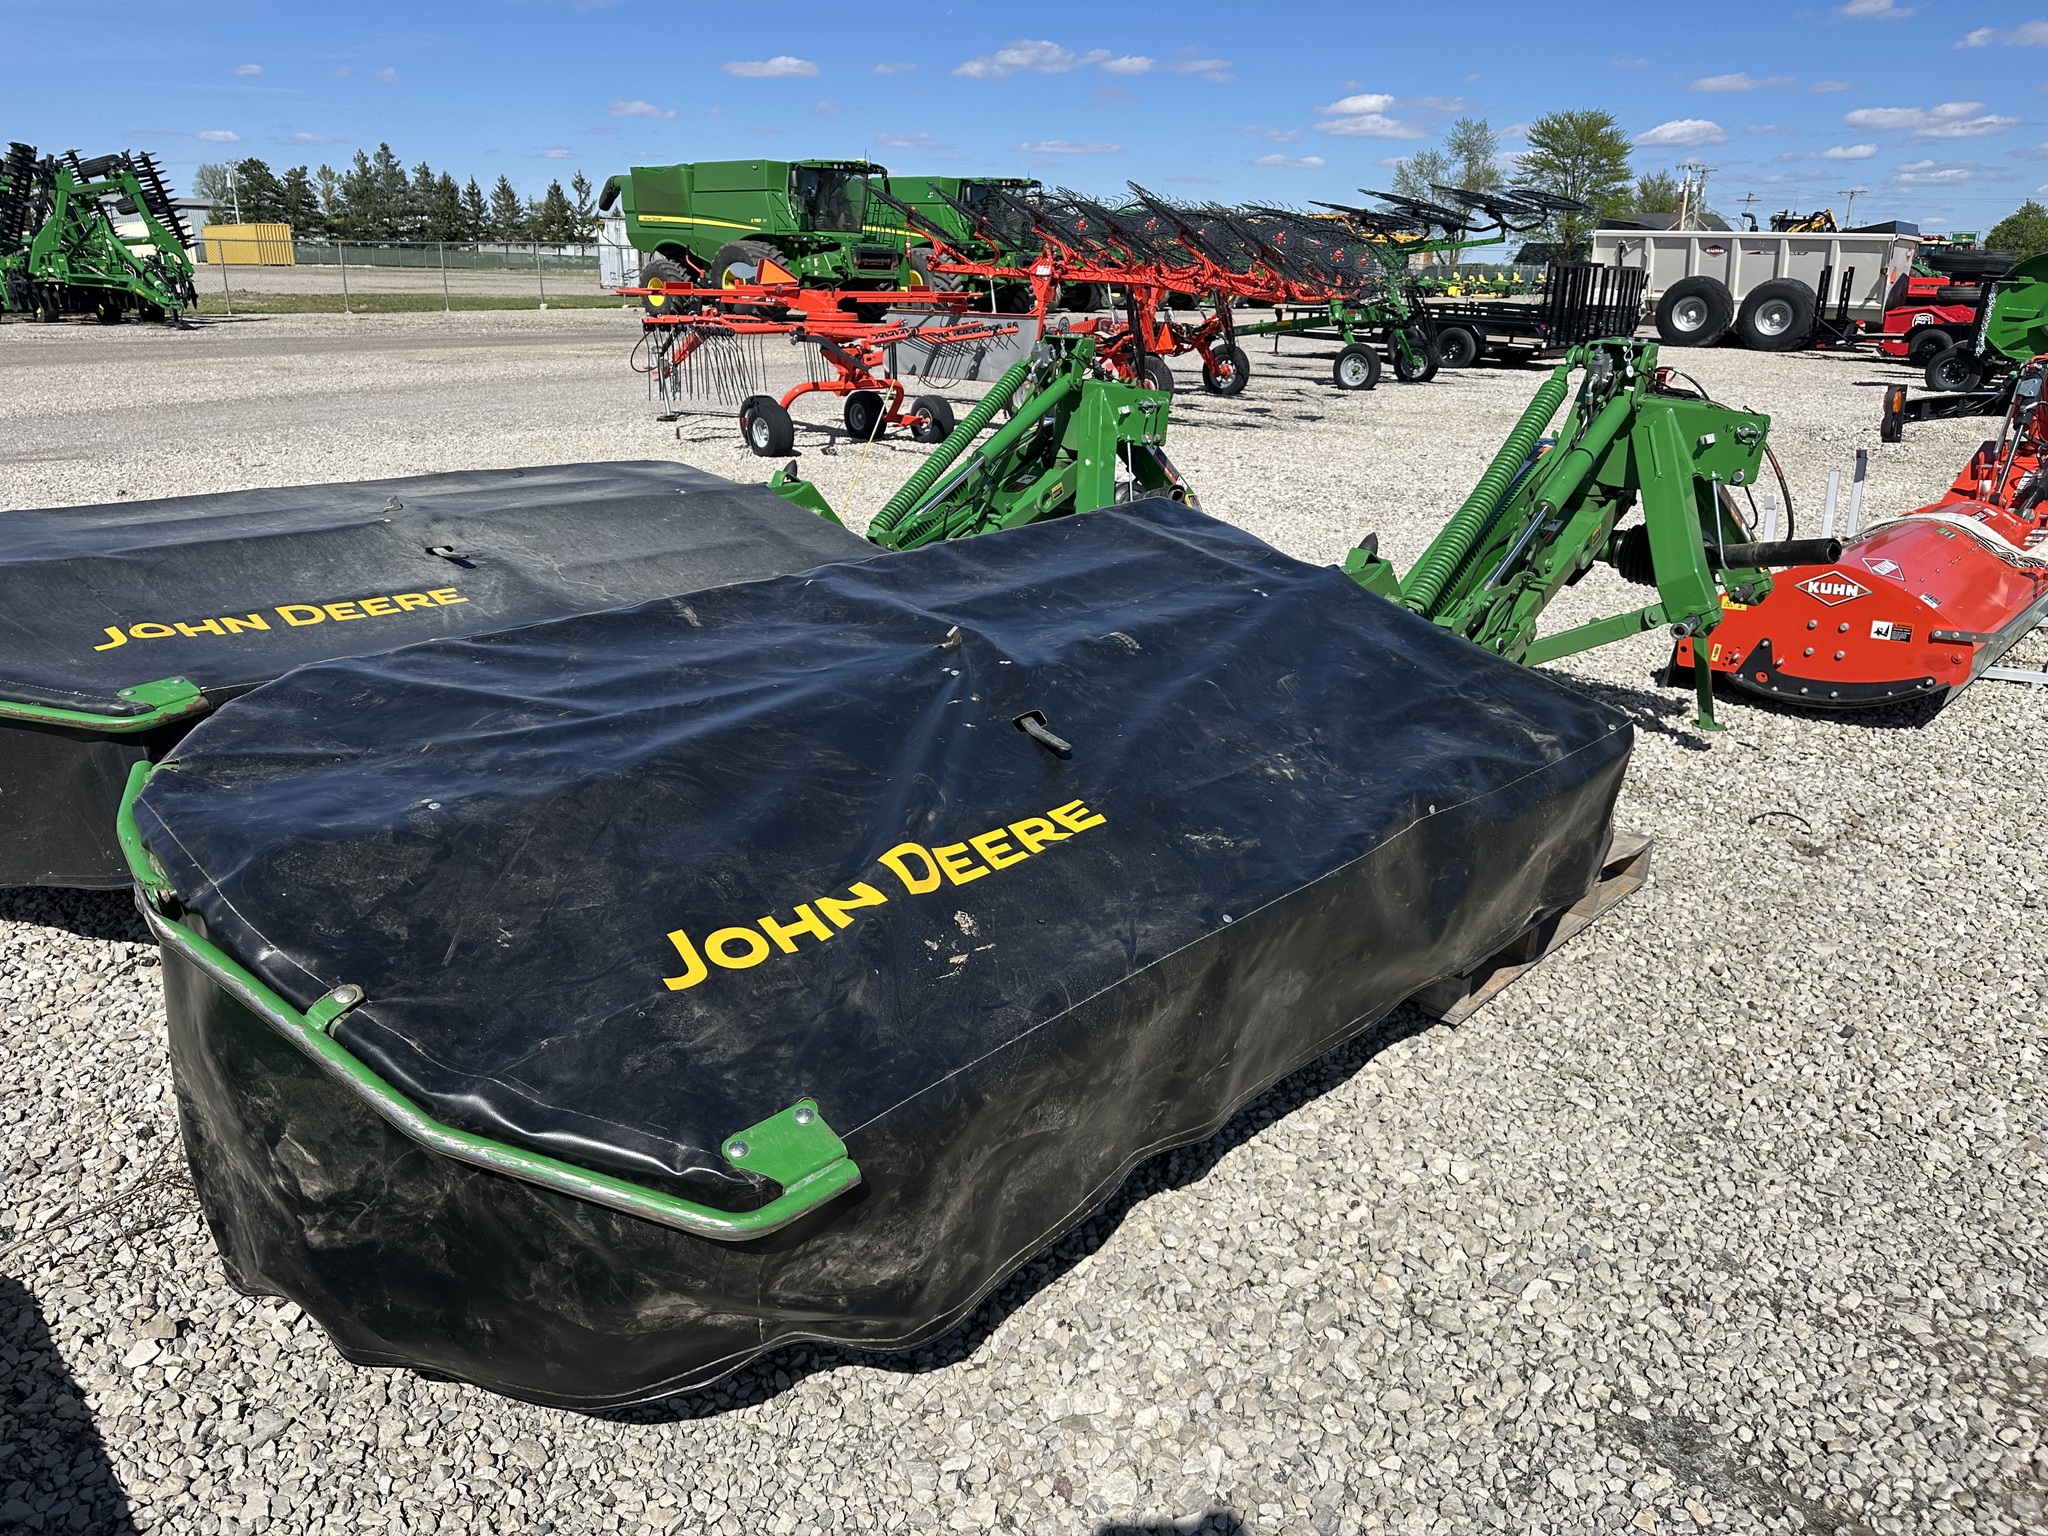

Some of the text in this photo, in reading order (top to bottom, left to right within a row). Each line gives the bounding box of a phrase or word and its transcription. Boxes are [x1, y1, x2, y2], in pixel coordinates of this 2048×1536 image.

[93, 587, 470, 652] JOHN DEERE
[1807, 581, 1860, 598] KUHN
[662, 798, 1107, 991] JOHN DEERE
